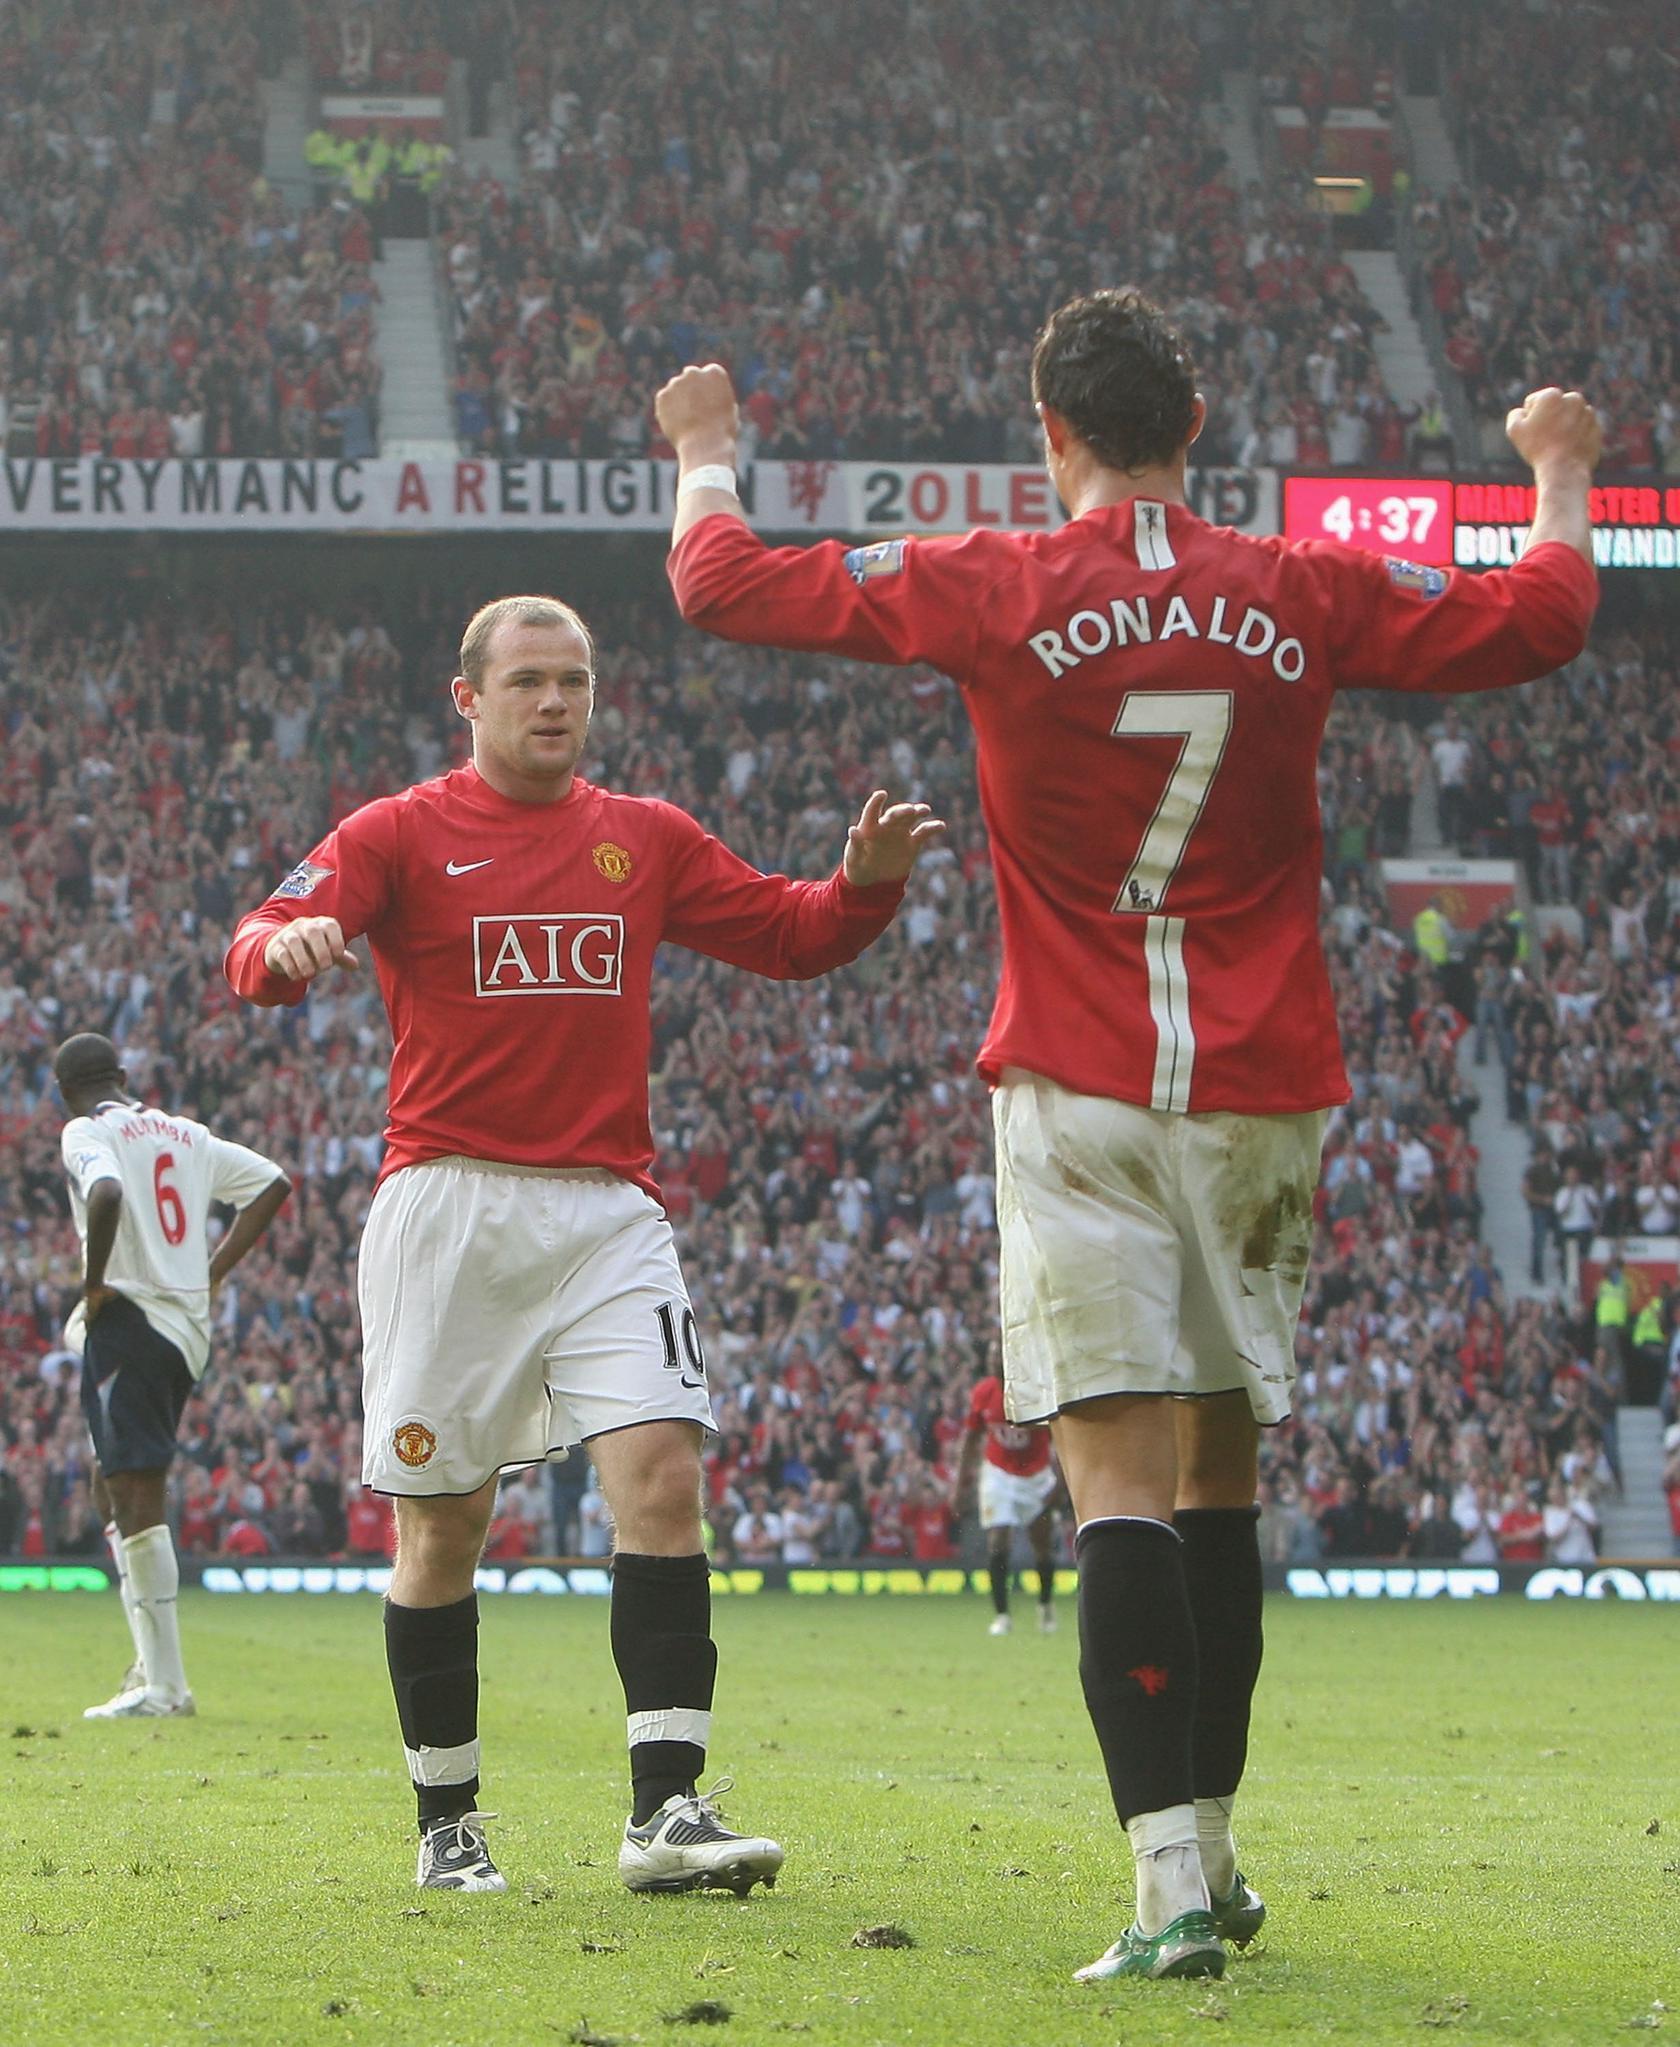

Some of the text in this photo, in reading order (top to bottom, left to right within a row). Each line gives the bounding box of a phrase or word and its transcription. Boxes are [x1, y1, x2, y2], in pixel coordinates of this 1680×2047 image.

[396, 462, 430, 513] A
[1321, 496, 1438, 543] 4:37
[1028, 596, 1305, 682] RONALDO
[1111, 690, 1234, 914] 7
[485, 924, 616, 985] AIG
[154, 1152, 187, 1248] 6
[653, 1301, 704, 1376] 10
